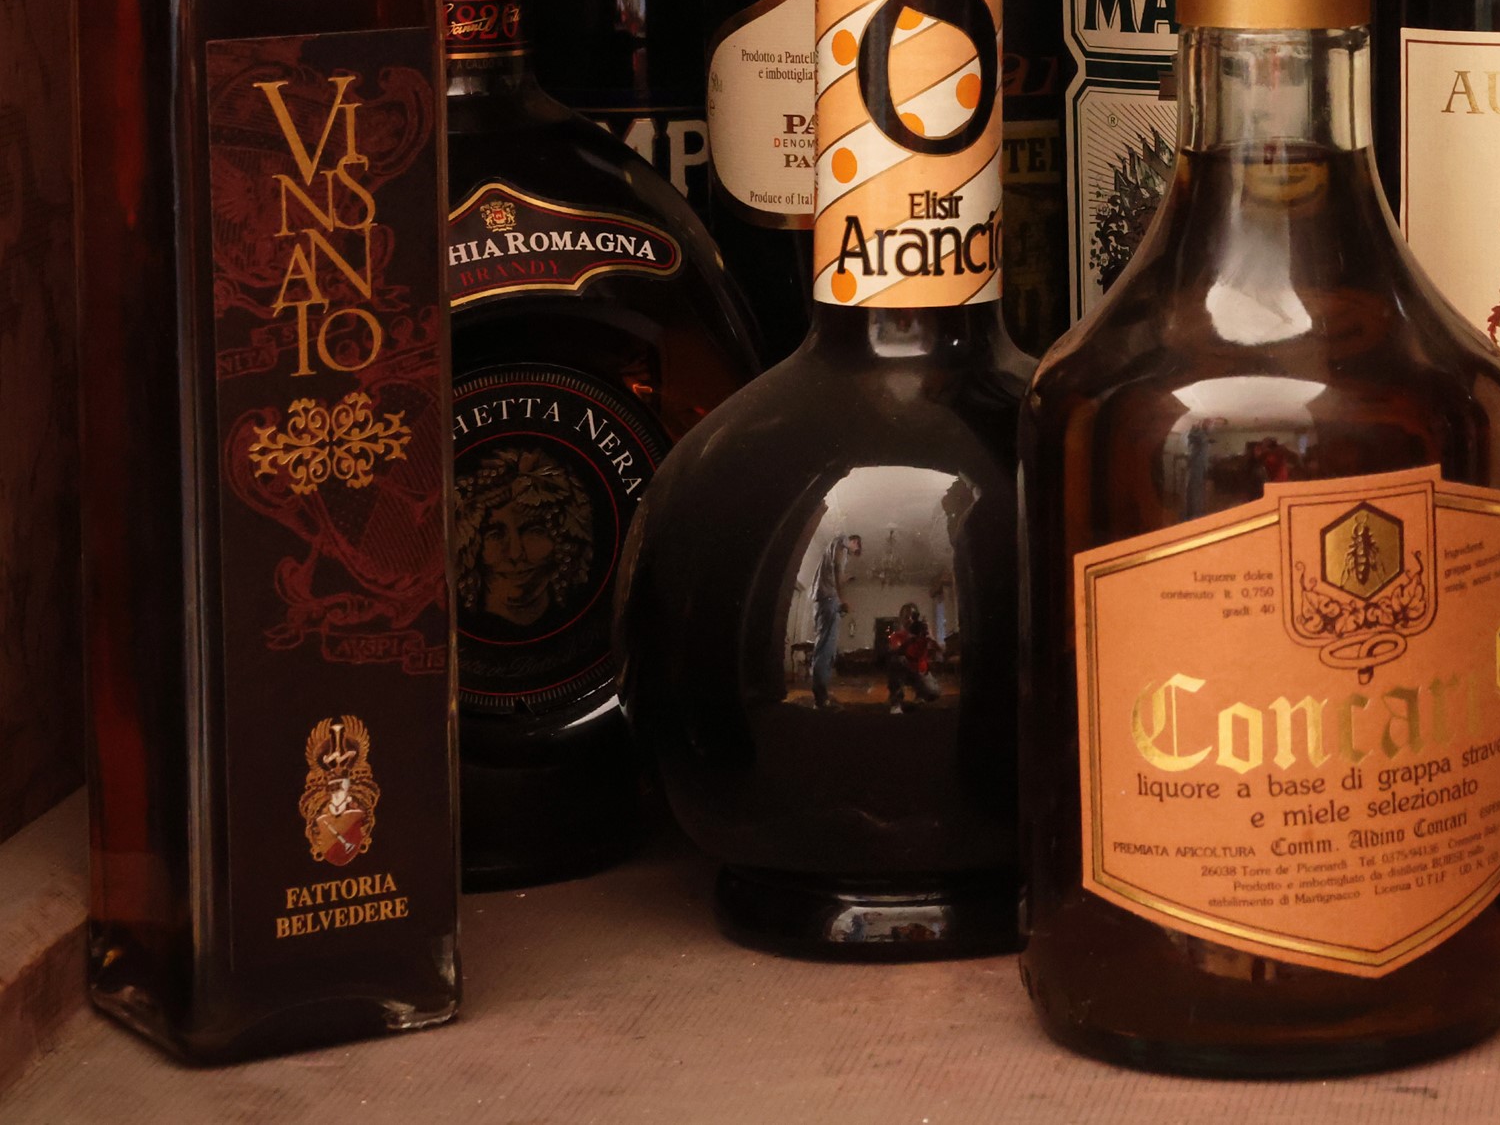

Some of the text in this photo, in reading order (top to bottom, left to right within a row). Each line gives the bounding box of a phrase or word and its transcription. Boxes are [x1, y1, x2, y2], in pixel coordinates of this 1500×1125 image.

[741, 49, 776, 64] Prodotto
[750, 190, 814, 206] Produce of Ital
[908, 191, 964, 221] Elisir
[504, 230, 657, 262] ROMAGNA
[459, 259, 562, 287] BRANDY
[452, 396, 645, 496] HETTA NERA
[1138, 773, 1220, 802] liquore
[1237, 780, 1251, 798] a
[1267, 774, 1326, 796] base
[1341, 766, 1363, 790] di
[1378, 756, 1451, 792] grappa
[1250, 811, 1265, 828] e
[1283, 800, 1350, 827] miele
[1367, 777, 1479, 818] selezionato
[1113, 841, 1169, 857] PREMIATA
[1175, 845, 1256, 859] APICOLTURA
[1242, 865, 1271, 876] Torre
[286, 873, 397, 910] FATTORIA
[276, 897, 409, 939] BELVEDERE
